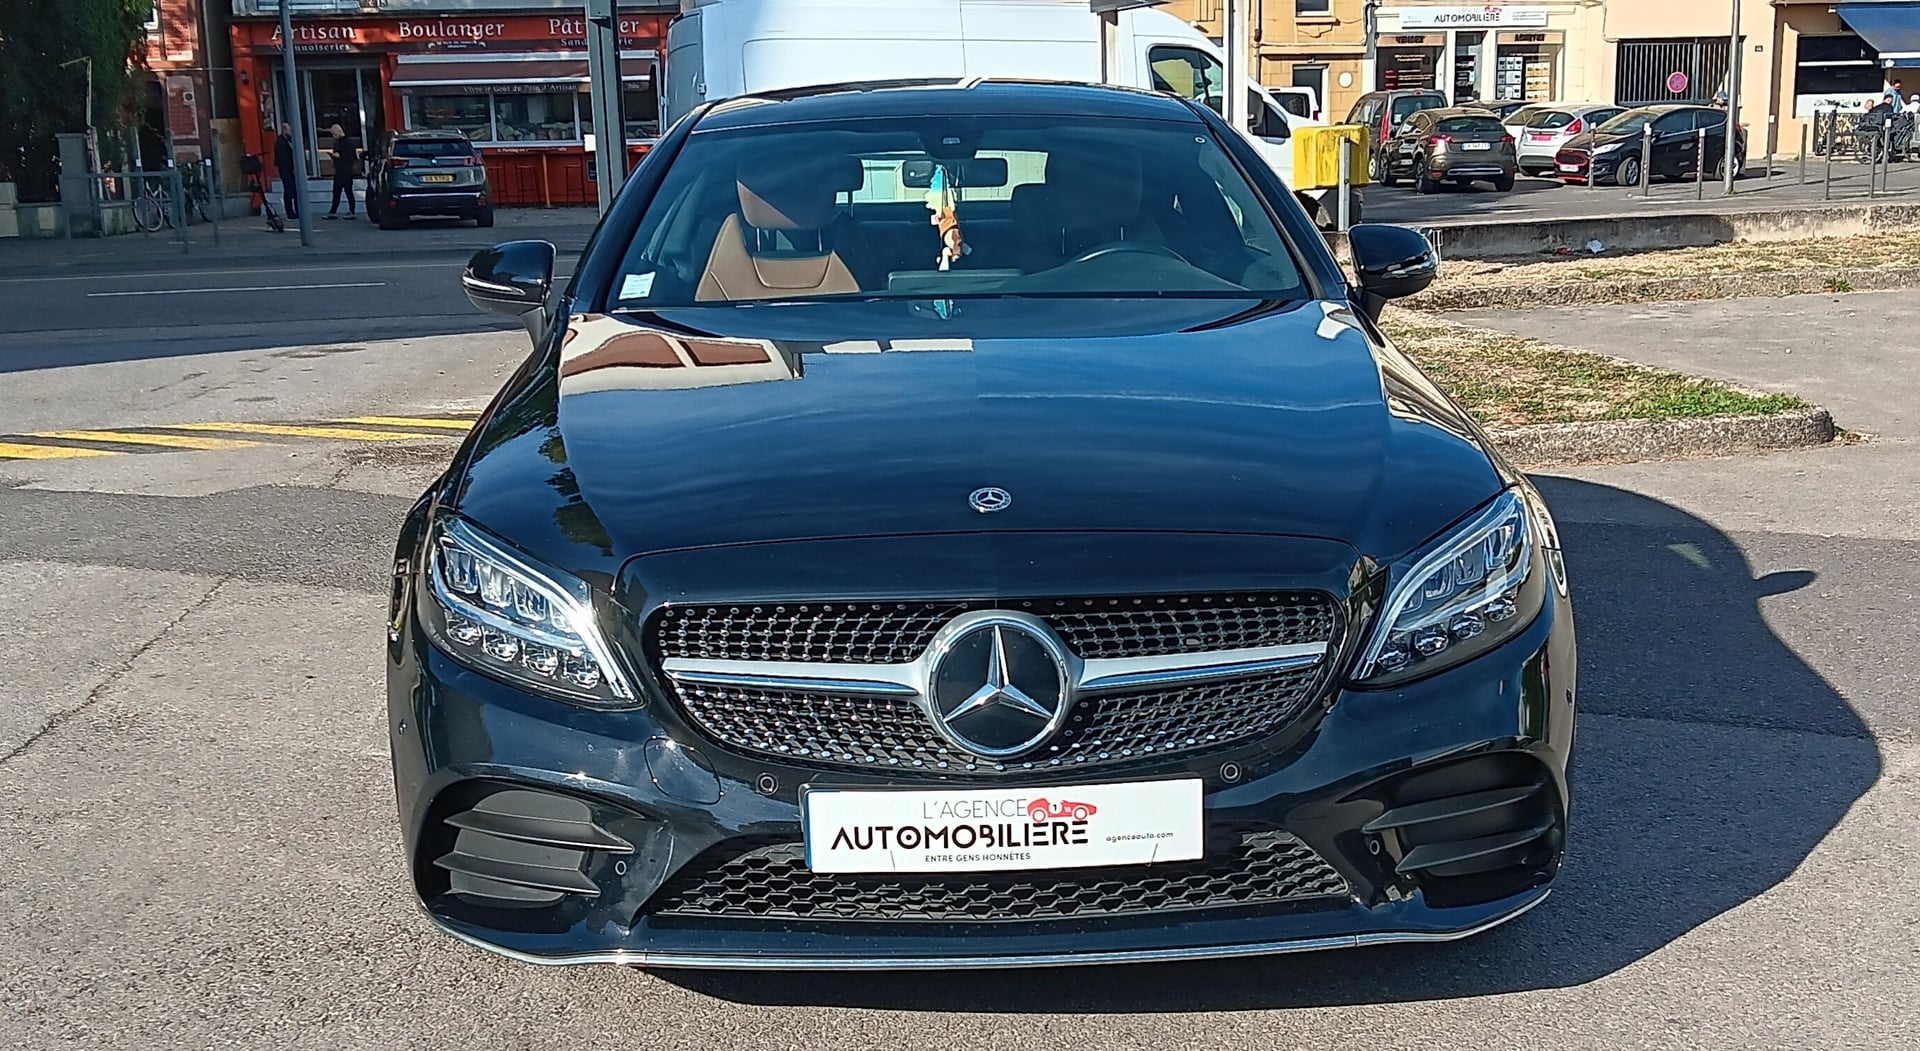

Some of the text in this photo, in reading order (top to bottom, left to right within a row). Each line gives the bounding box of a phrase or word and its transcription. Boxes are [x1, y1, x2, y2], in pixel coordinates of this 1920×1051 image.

[271, 18, 640, 40] Artisan Boulanger Pâter
[276, 43, 351, 52] Vnnoiseries
[923, 798, 1028, 820] L'AGENCE
[1052, 804, 1058, 812] 1
[1106, 832, 1174, 843] agenceauto.com
[925, 855, 954, 863] ENTRE
[956, 854, 980, 862] GENS
